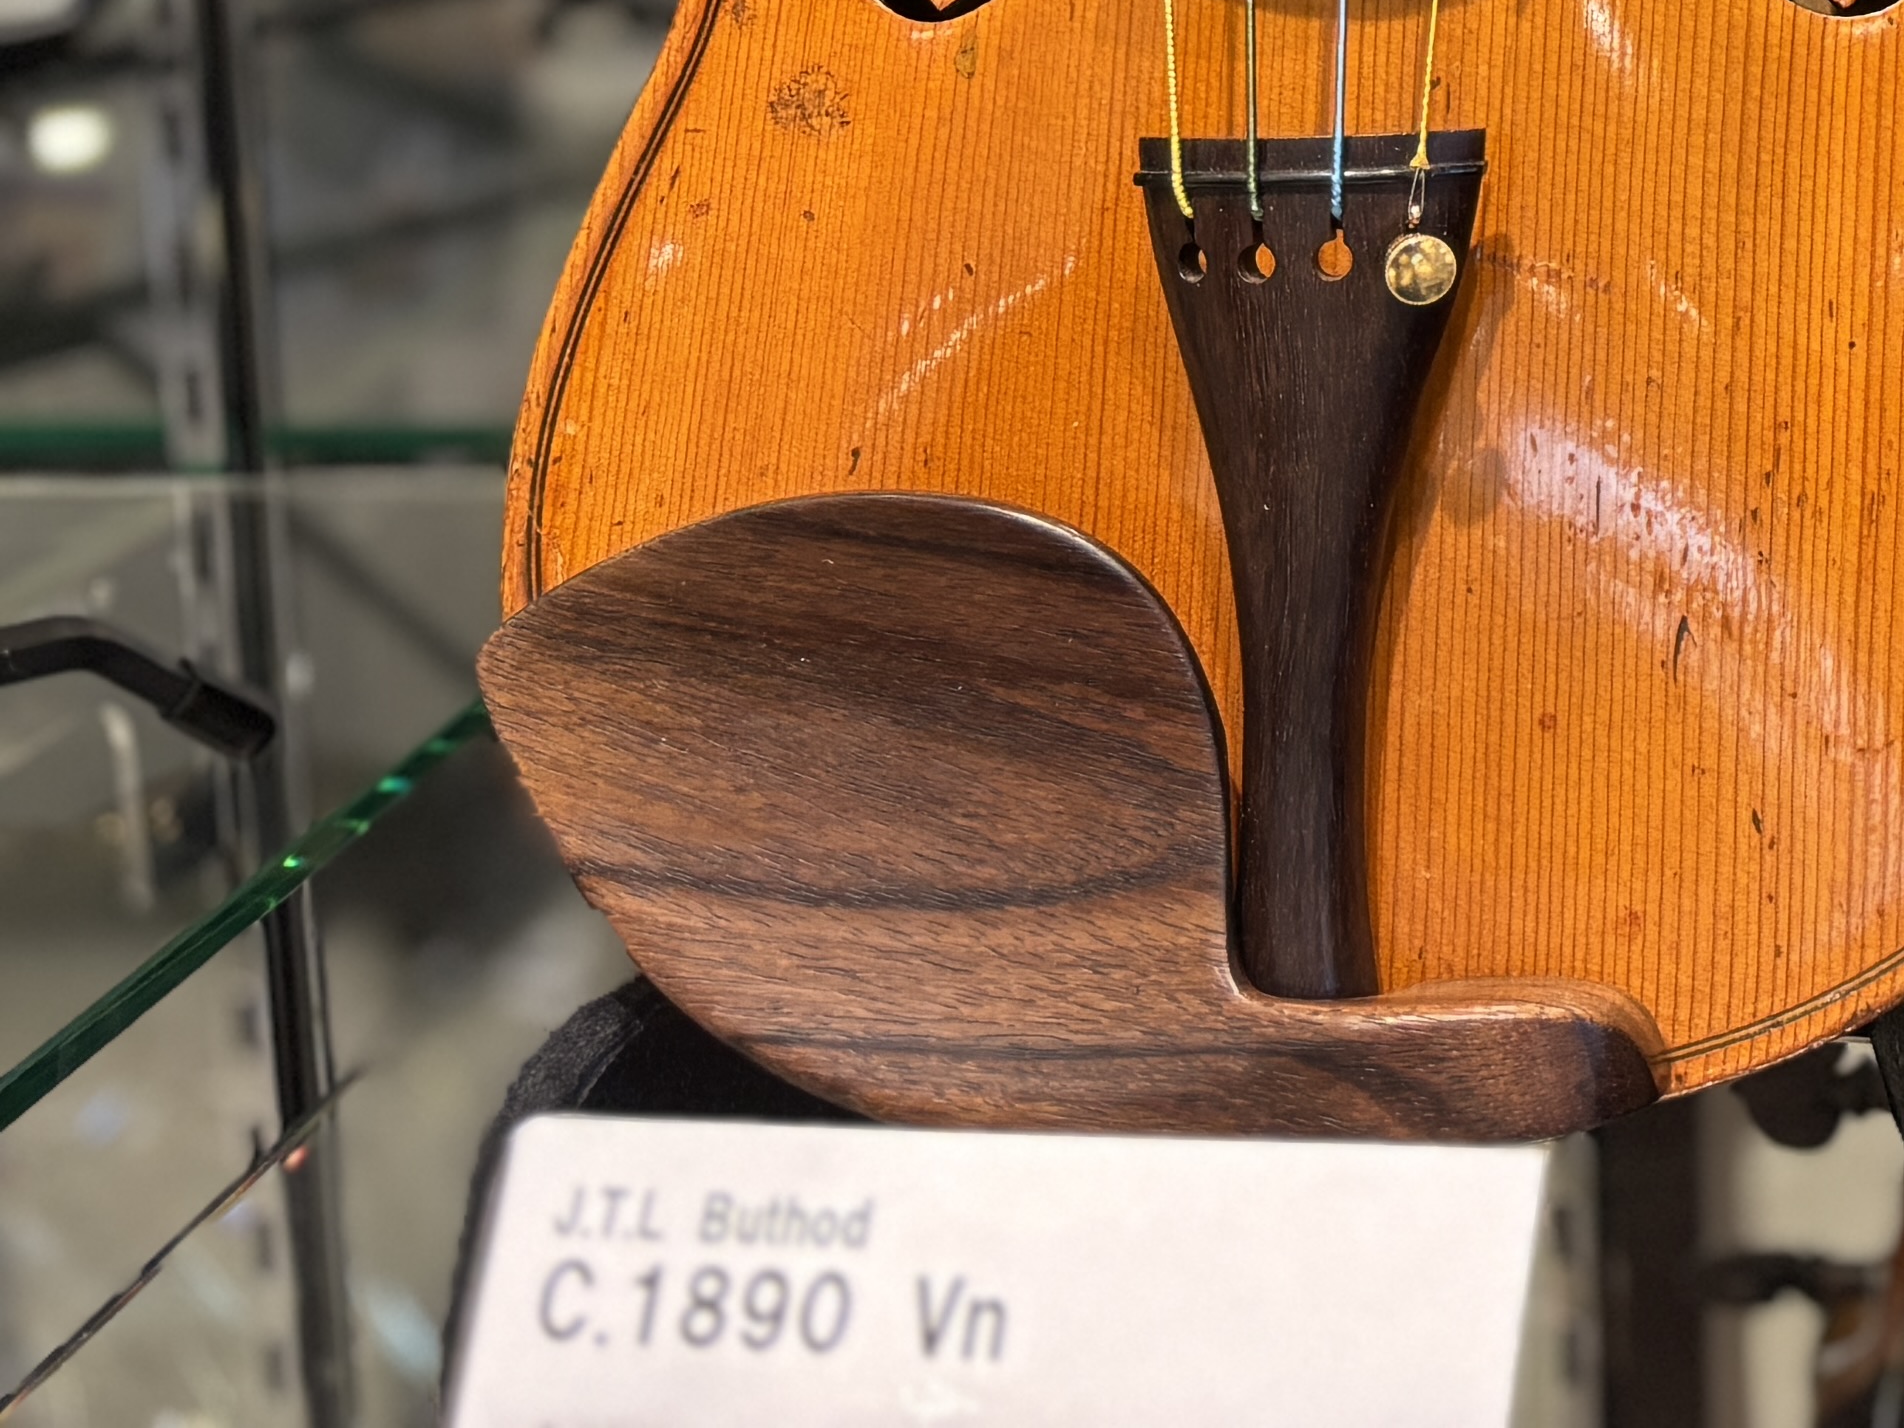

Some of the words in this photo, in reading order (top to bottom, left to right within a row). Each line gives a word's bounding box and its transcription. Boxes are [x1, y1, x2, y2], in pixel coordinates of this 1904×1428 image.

[698, 1191, 873, 1250] Buthod
[537, 1256, 854, 1357] C.1890
[915, 1273, 1009, 1363] Vn
